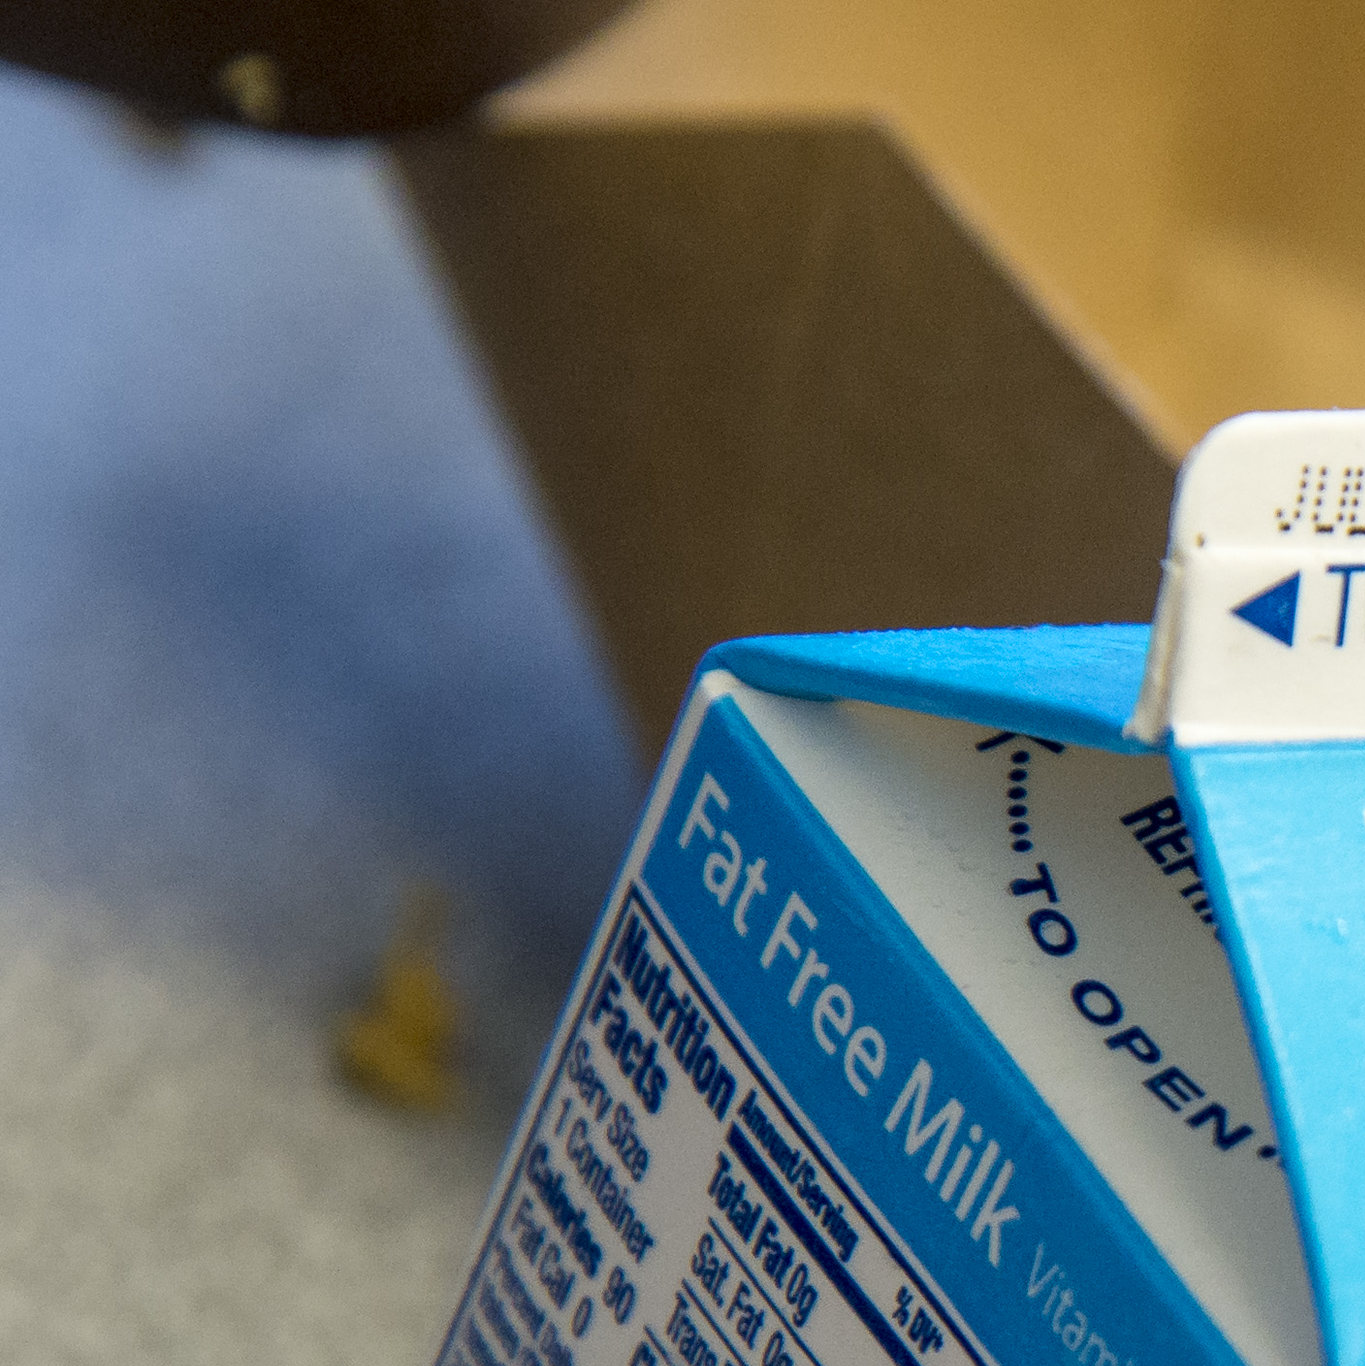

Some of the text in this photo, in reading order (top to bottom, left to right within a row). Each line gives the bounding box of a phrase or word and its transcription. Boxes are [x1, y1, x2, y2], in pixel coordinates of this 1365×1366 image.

[589, 970, 669, 1114] Facts
[614, 914, 737, 1120] Nutrition
[678, 772, 1019, 1265] Fat Free Milk
[1011, 862, 1079, 958] TO
[1069, 978, 1254, 1154] OPEN
[553, 1095, 656, 1262] 1 Container
[566, 1036, 651, 1183] Serv Size
[738, 1089, 859, 1263] Amount/Serving
[513, 1195, 595, 1339] Fat Cal 0
[526, 1141, 637, 1324] Calories 90
[691, 1231, 731, 1308] Sat.
[726, 1280, 766, 1350] Fat
[708, 1152, 819, 1329] Total Fat 0g
[892, 1284, 914, 1328] %
